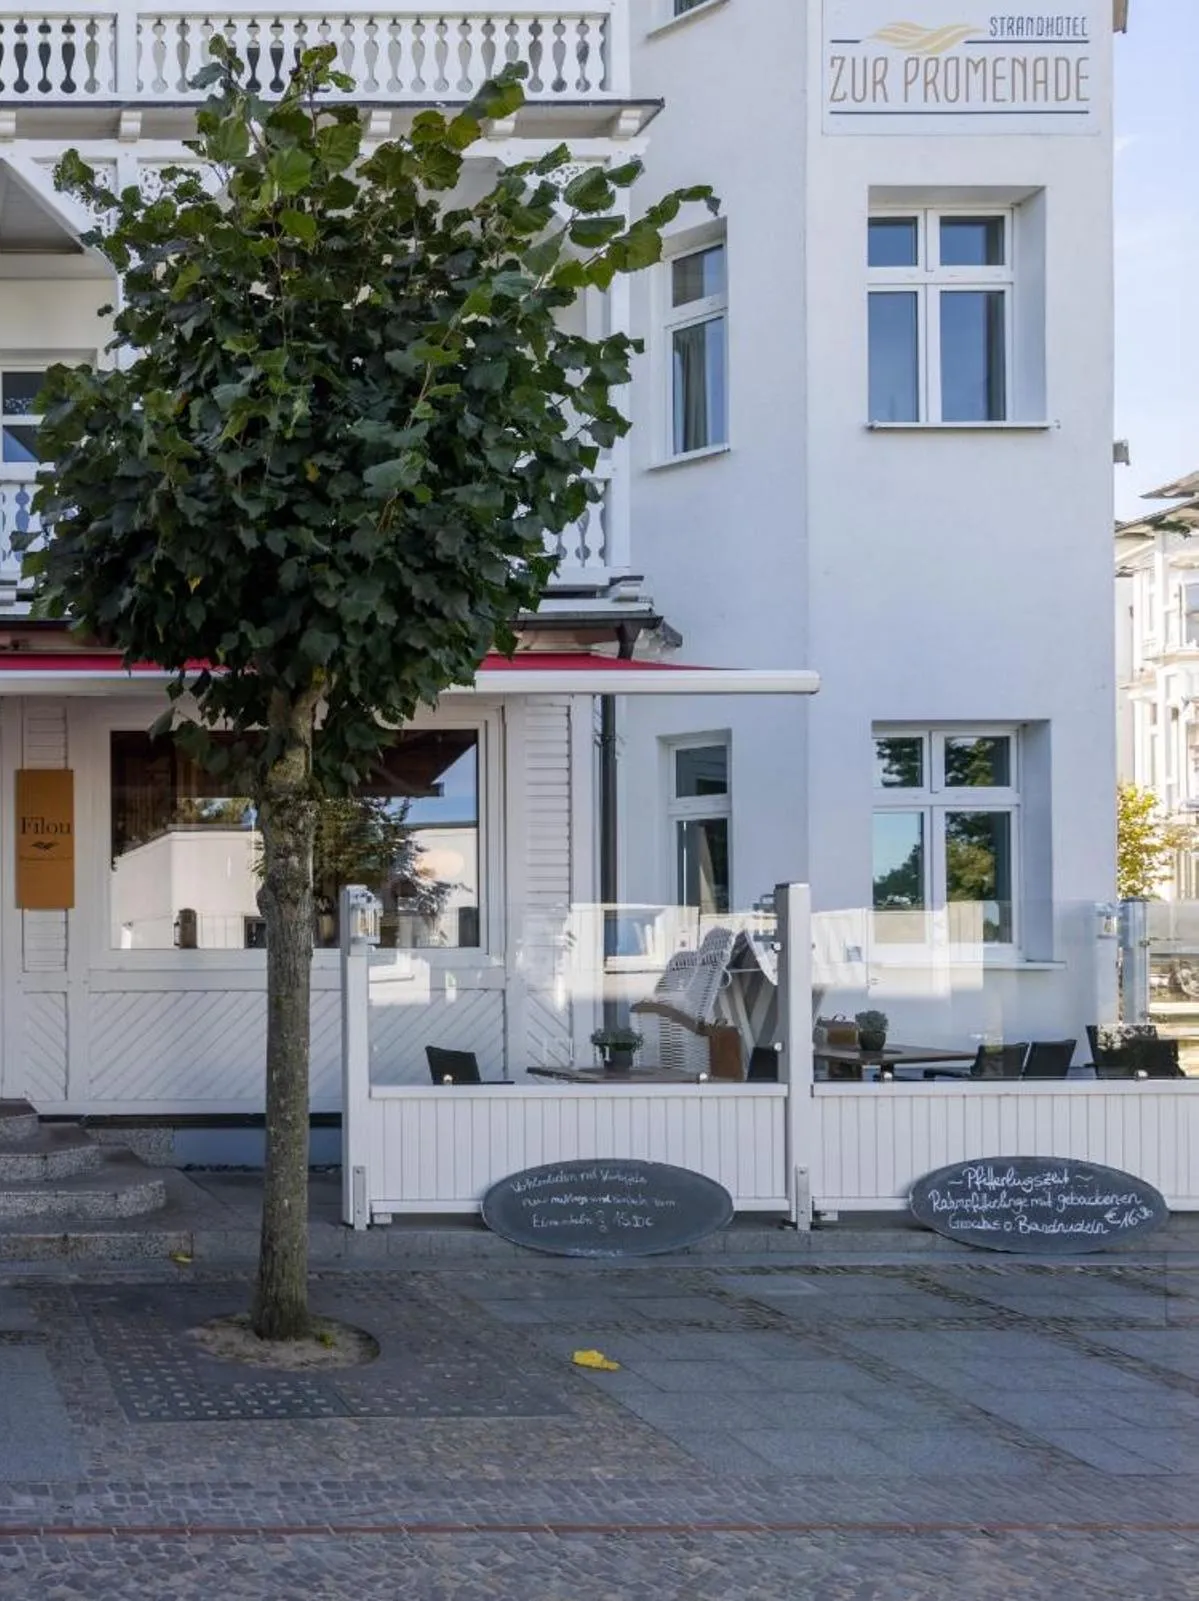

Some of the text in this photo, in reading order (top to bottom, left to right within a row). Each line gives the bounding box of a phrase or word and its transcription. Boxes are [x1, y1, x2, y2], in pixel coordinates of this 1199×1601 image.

[989, 15, 1088, 37] STRANDHOTEL
[829, 55, 1090, 103] ZUR PROMENADE
[20, 815, 72, 836] Filou
